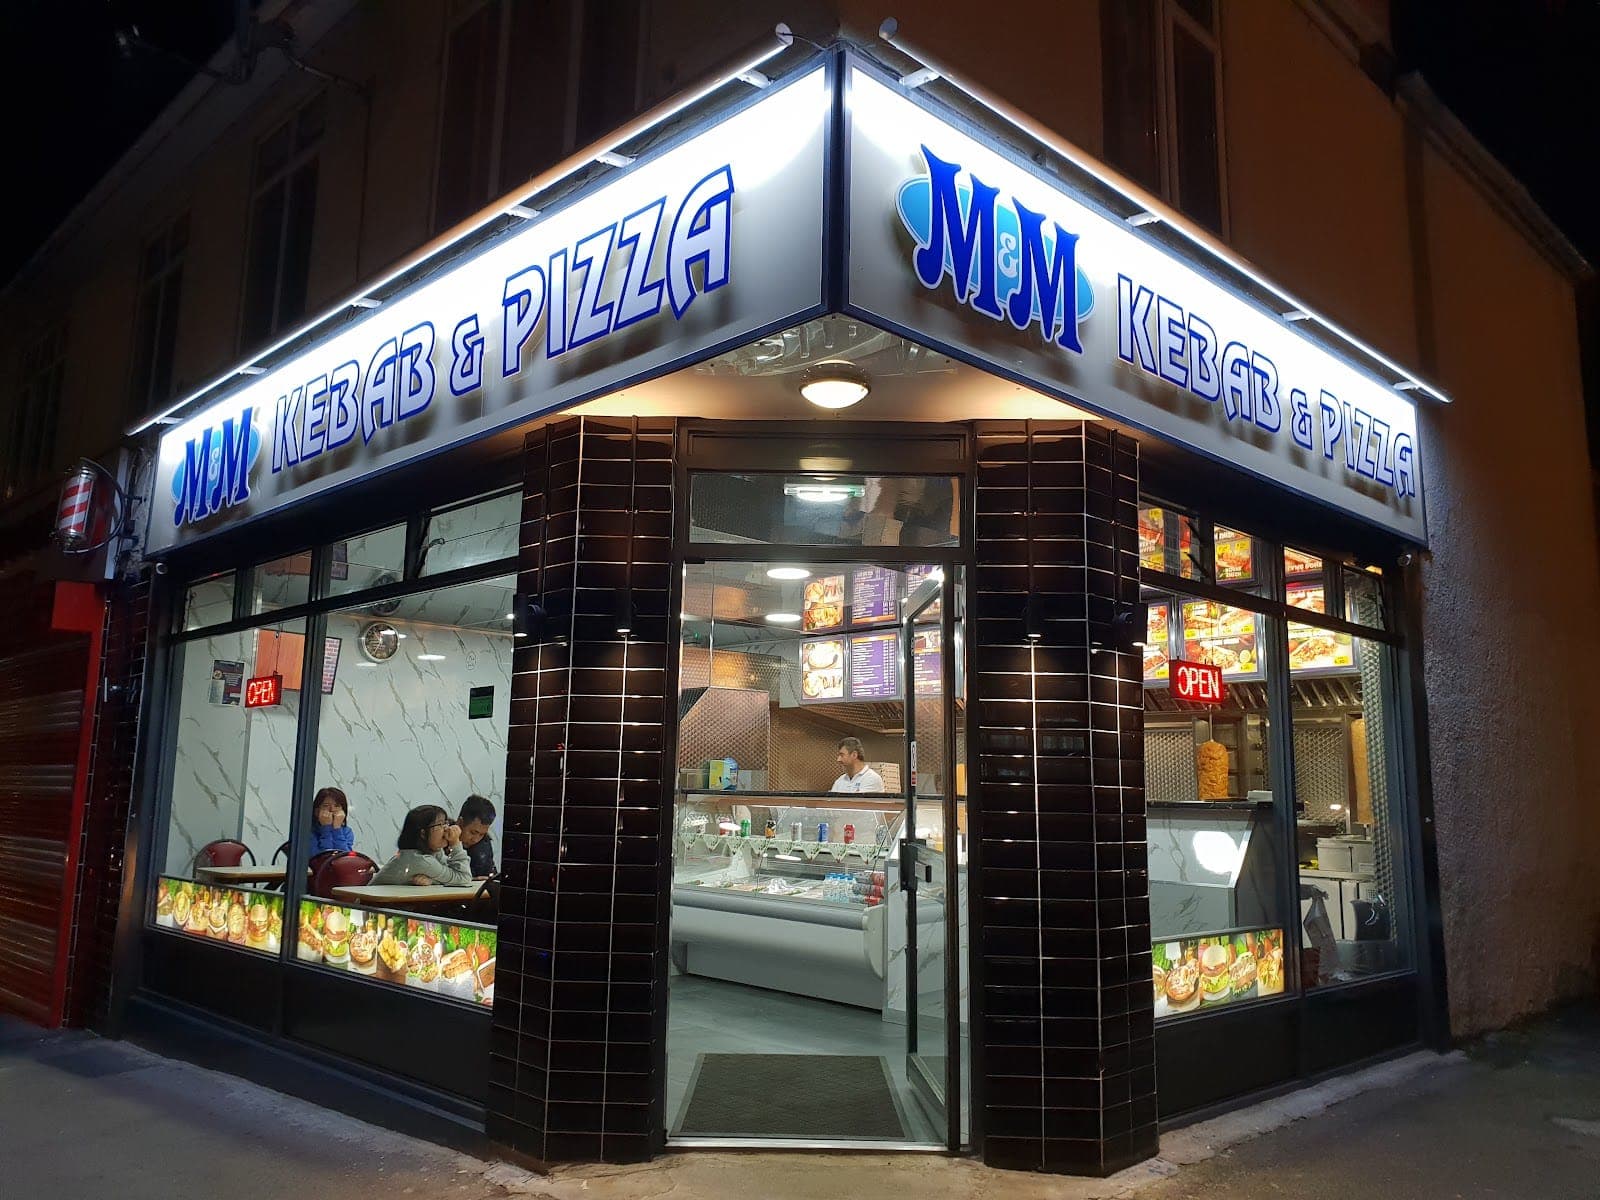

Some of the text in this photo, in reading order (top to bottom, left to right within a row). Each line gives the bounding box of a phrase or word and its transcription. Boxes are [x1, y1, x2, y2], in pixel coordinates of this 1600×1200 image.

[173, 163, 735, 528] M&M KEBAB & PIZZA
[912, 143, 1416, 499] M&M KEBAB & PIZZA
[248, 679, 275, 704] OPEN
[1177, 665, 1221, 699] OPEN
